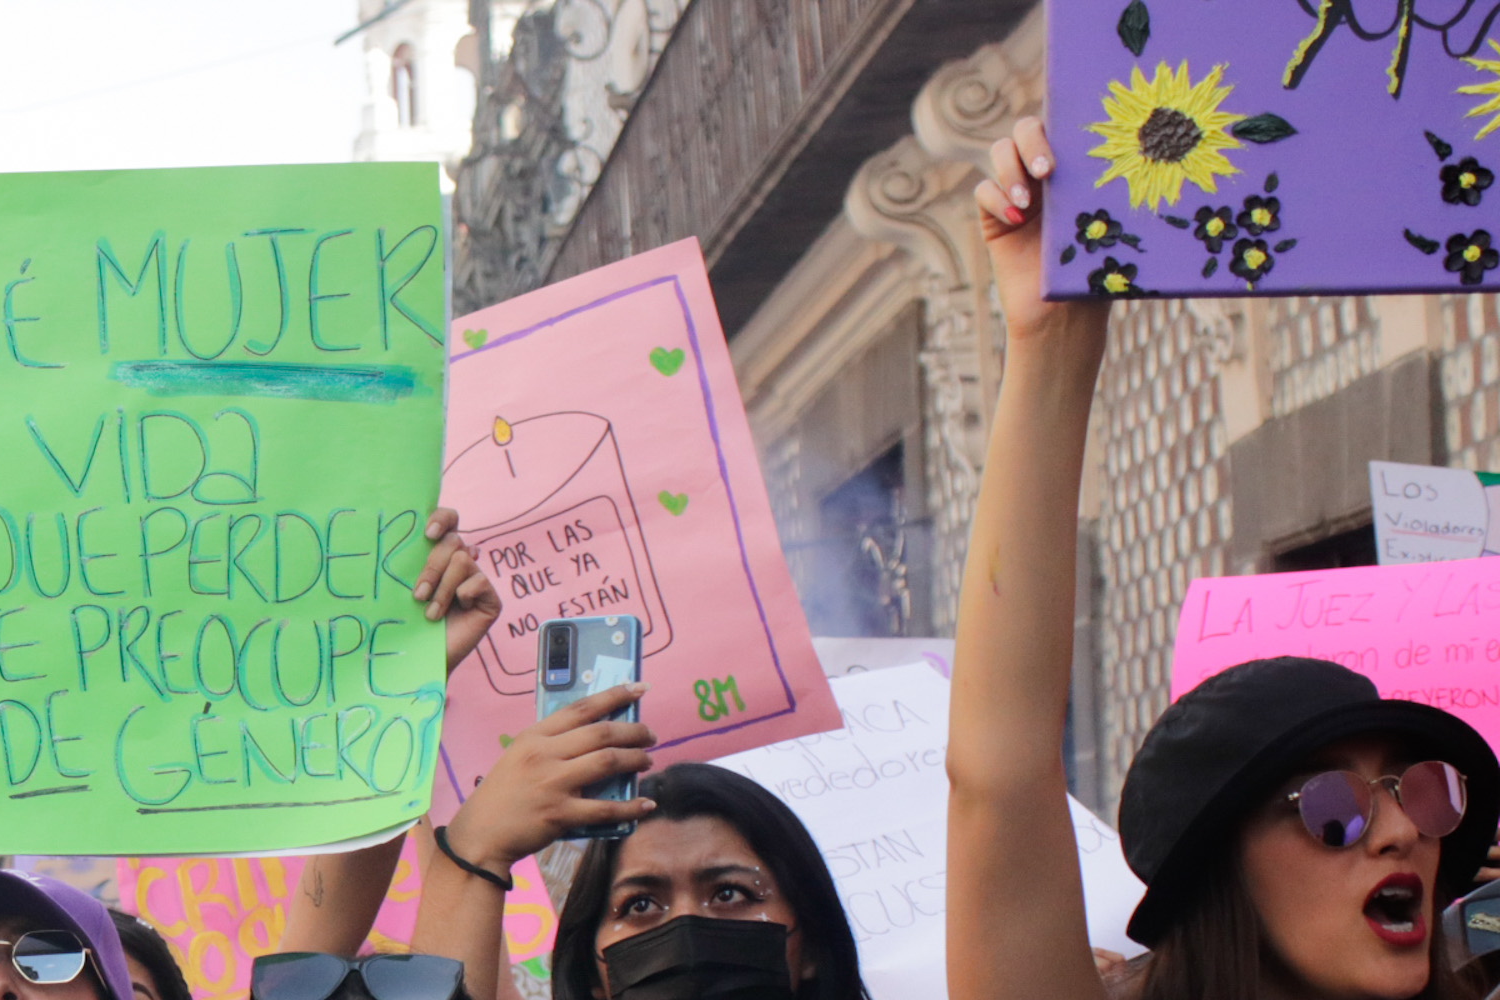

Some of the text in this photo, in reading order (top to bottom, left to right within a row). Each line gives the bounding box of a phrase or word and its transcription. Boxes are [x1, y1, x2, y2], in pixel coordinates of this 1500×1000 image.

[96, 224, 444, 361] MUJER
[1381, 469, 1439, 502] LOS
[139, 506, 420, 604] PERDER
[489, 519, 595, 578] POR LAS
[510, 551, 601, 599] QUE YA
[507, 575, 630, 640] NO ESTÁN
[1197, 589, 1254, 644] LA
[1275, 578, 1377, 631] JUEZ
[1396, 572, 1432, 624] Y
[70, 606, 426, 711] PREOCUPE
[1394, 638, 1431, 670] de
[693, 674, 746, 722] 8M
